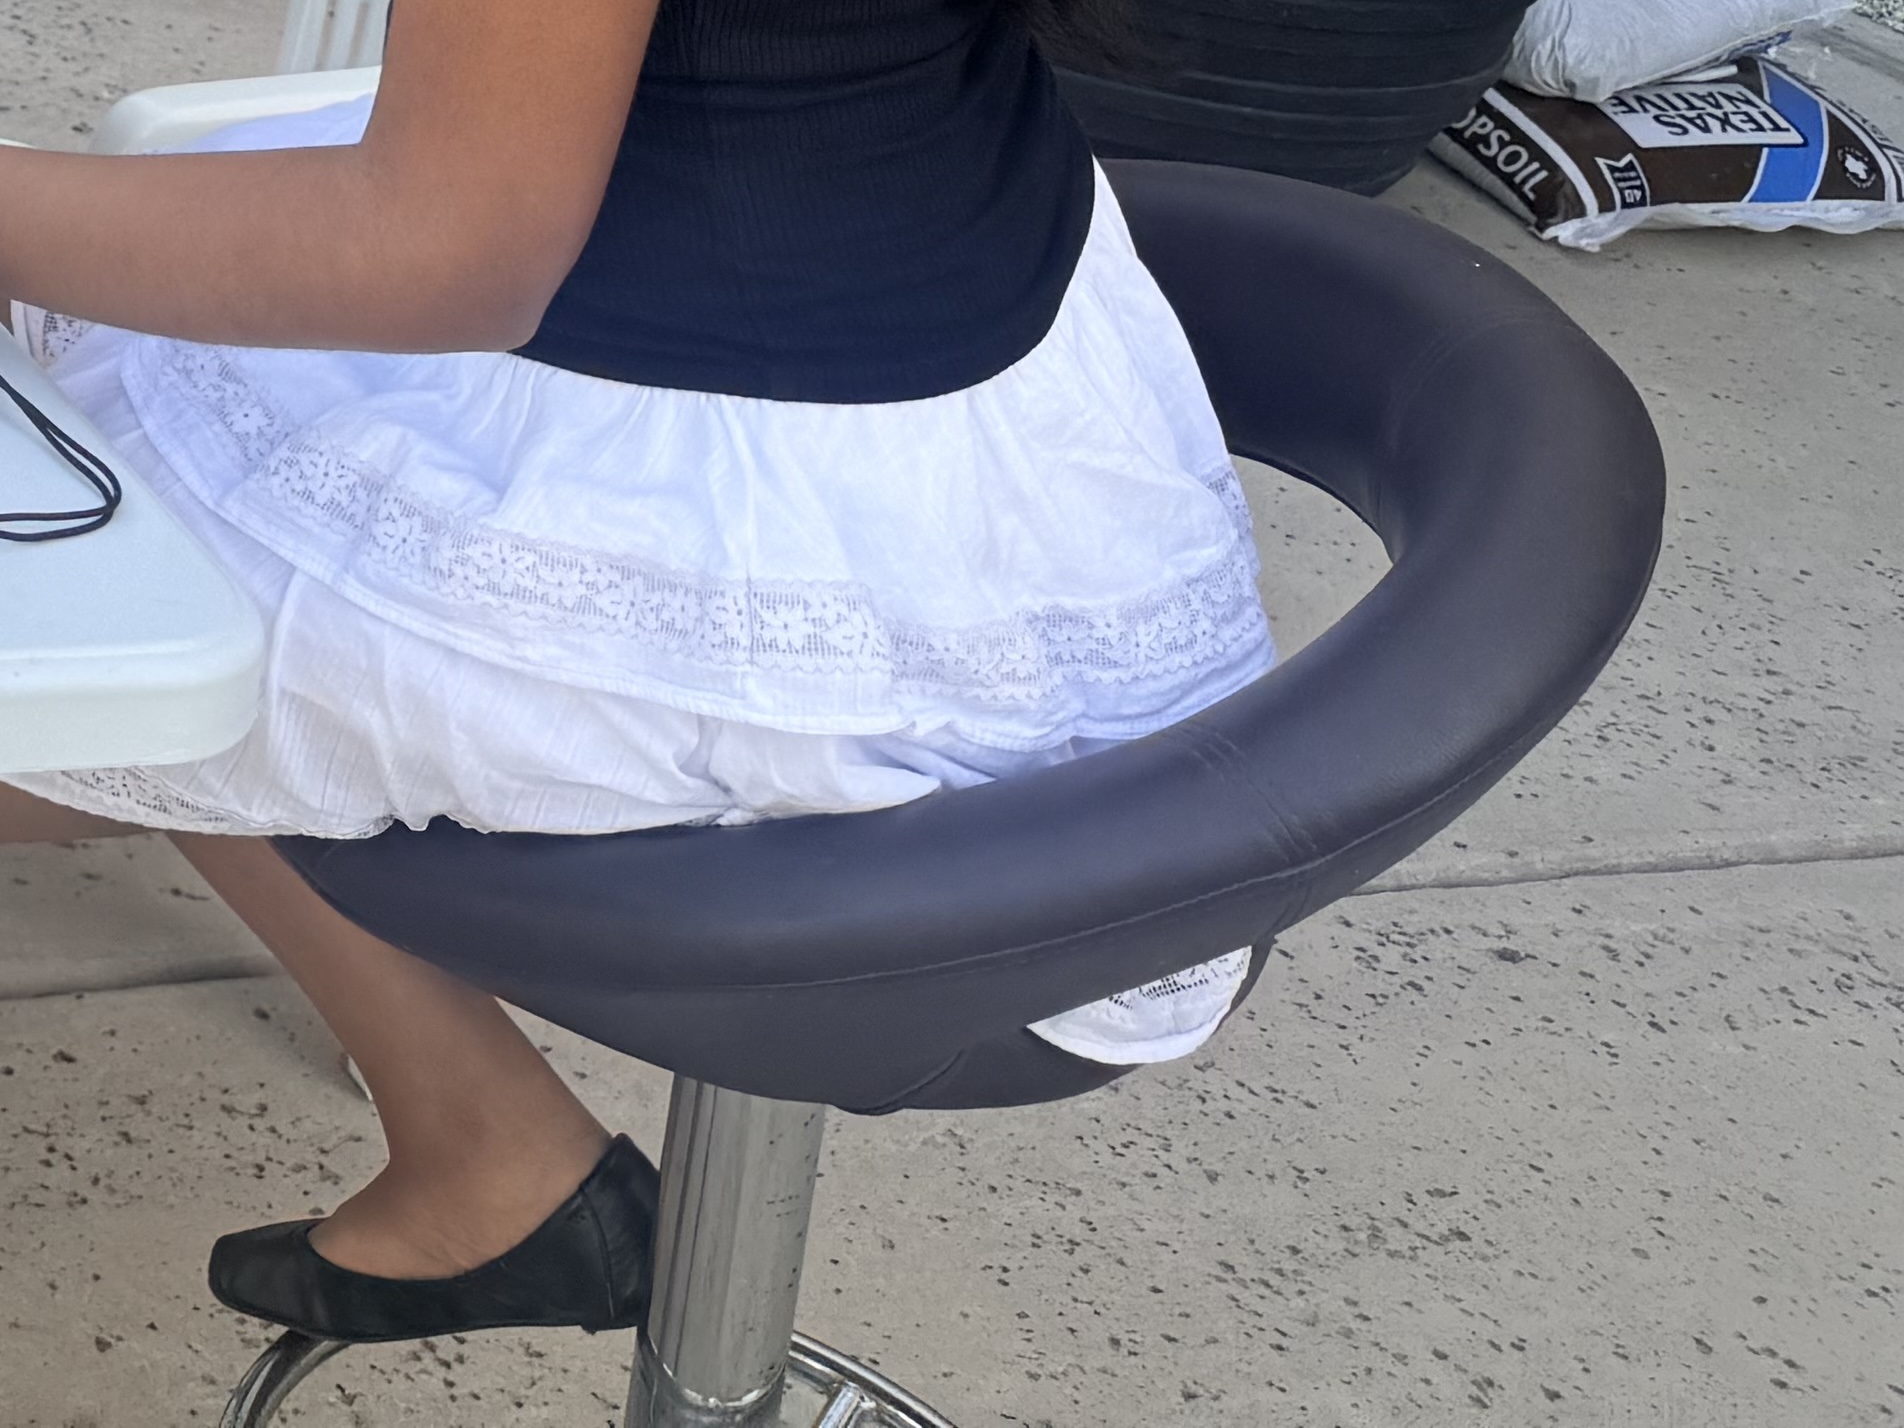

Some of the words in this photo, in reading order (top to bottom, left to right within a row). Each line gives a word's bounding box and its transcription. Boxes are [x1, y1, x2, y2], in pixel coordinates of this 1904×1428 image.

[1609, 89, 1759, 115] NATIVE
[1652, 110, 1790, 137] TEXAS
[1450, 106, 1549, 201] PSOIL
